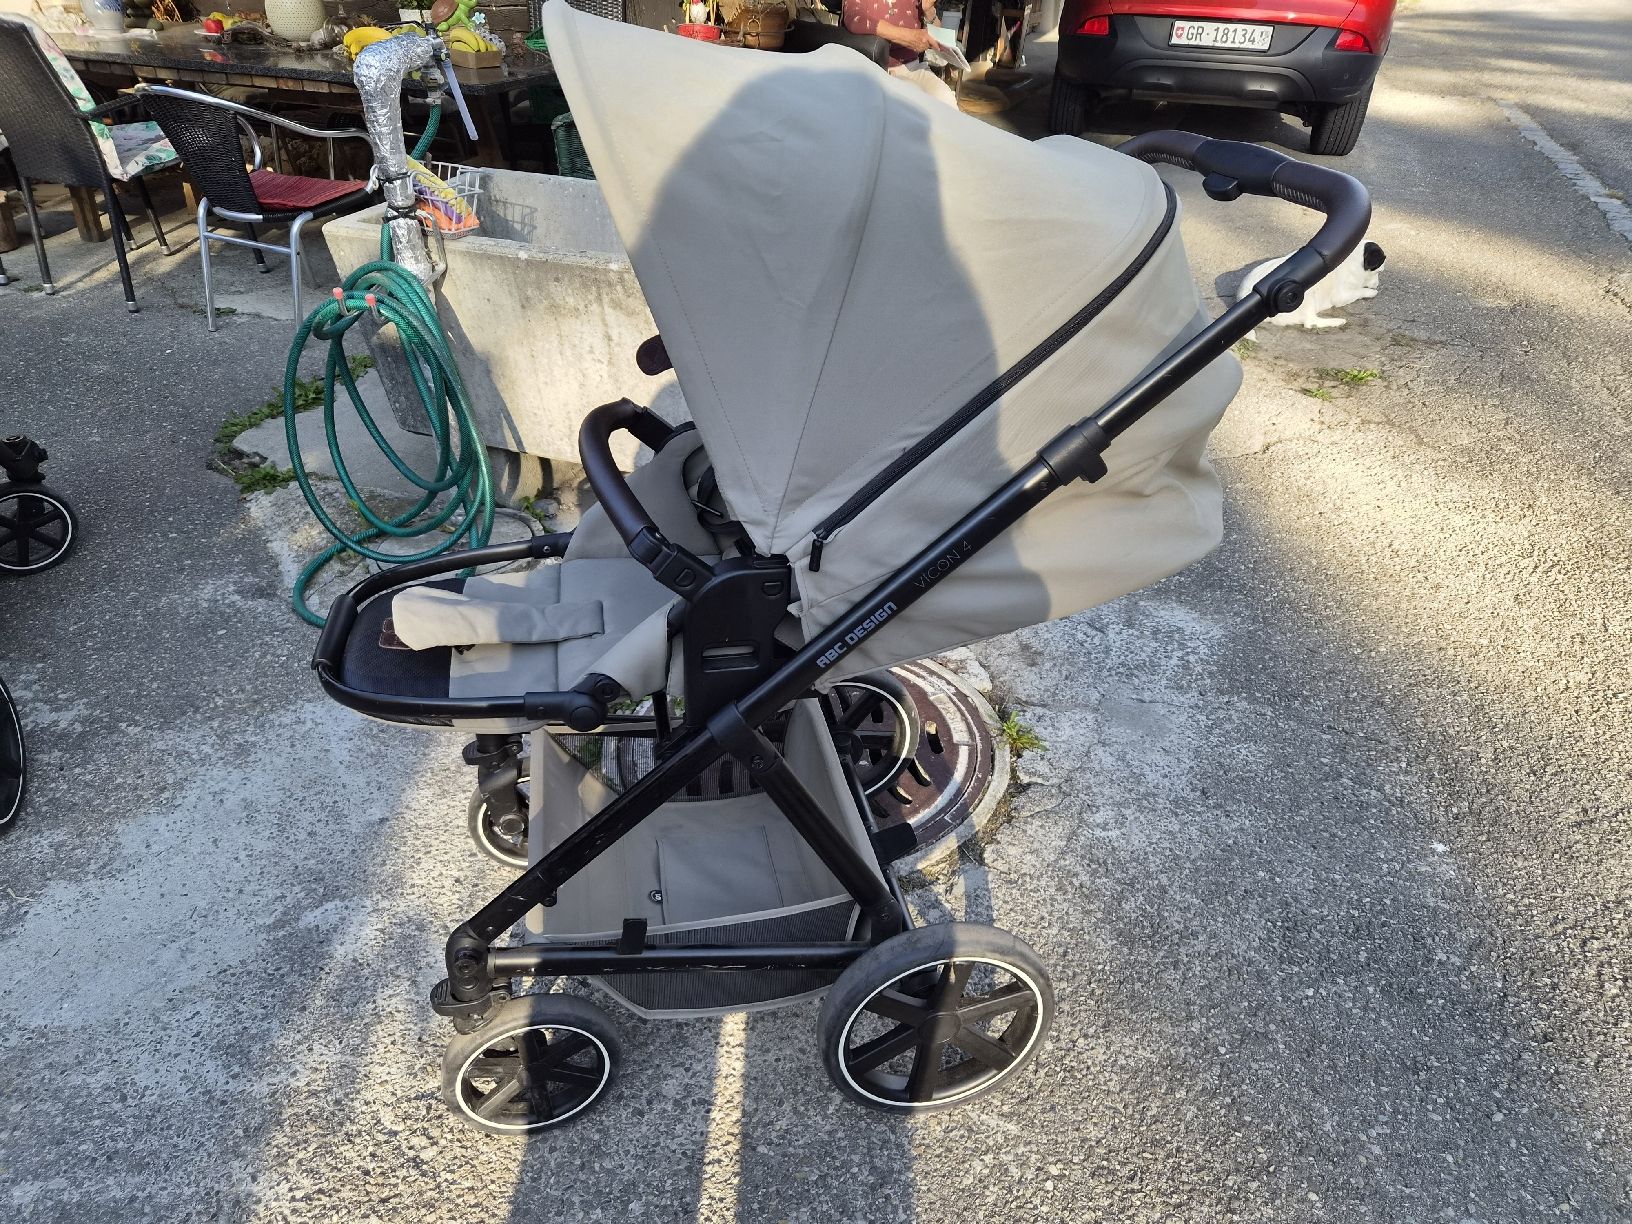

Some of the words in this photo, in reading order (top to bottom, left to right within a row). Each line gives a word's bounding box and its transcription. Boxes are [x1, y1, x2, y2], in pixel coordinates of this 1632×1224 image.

[915, 550, 961, 588] VICON
[962, 540, 972, 552] 4
[816, 642, 847, 668] ABC
[845, 601, 898, 646] DESIGN
